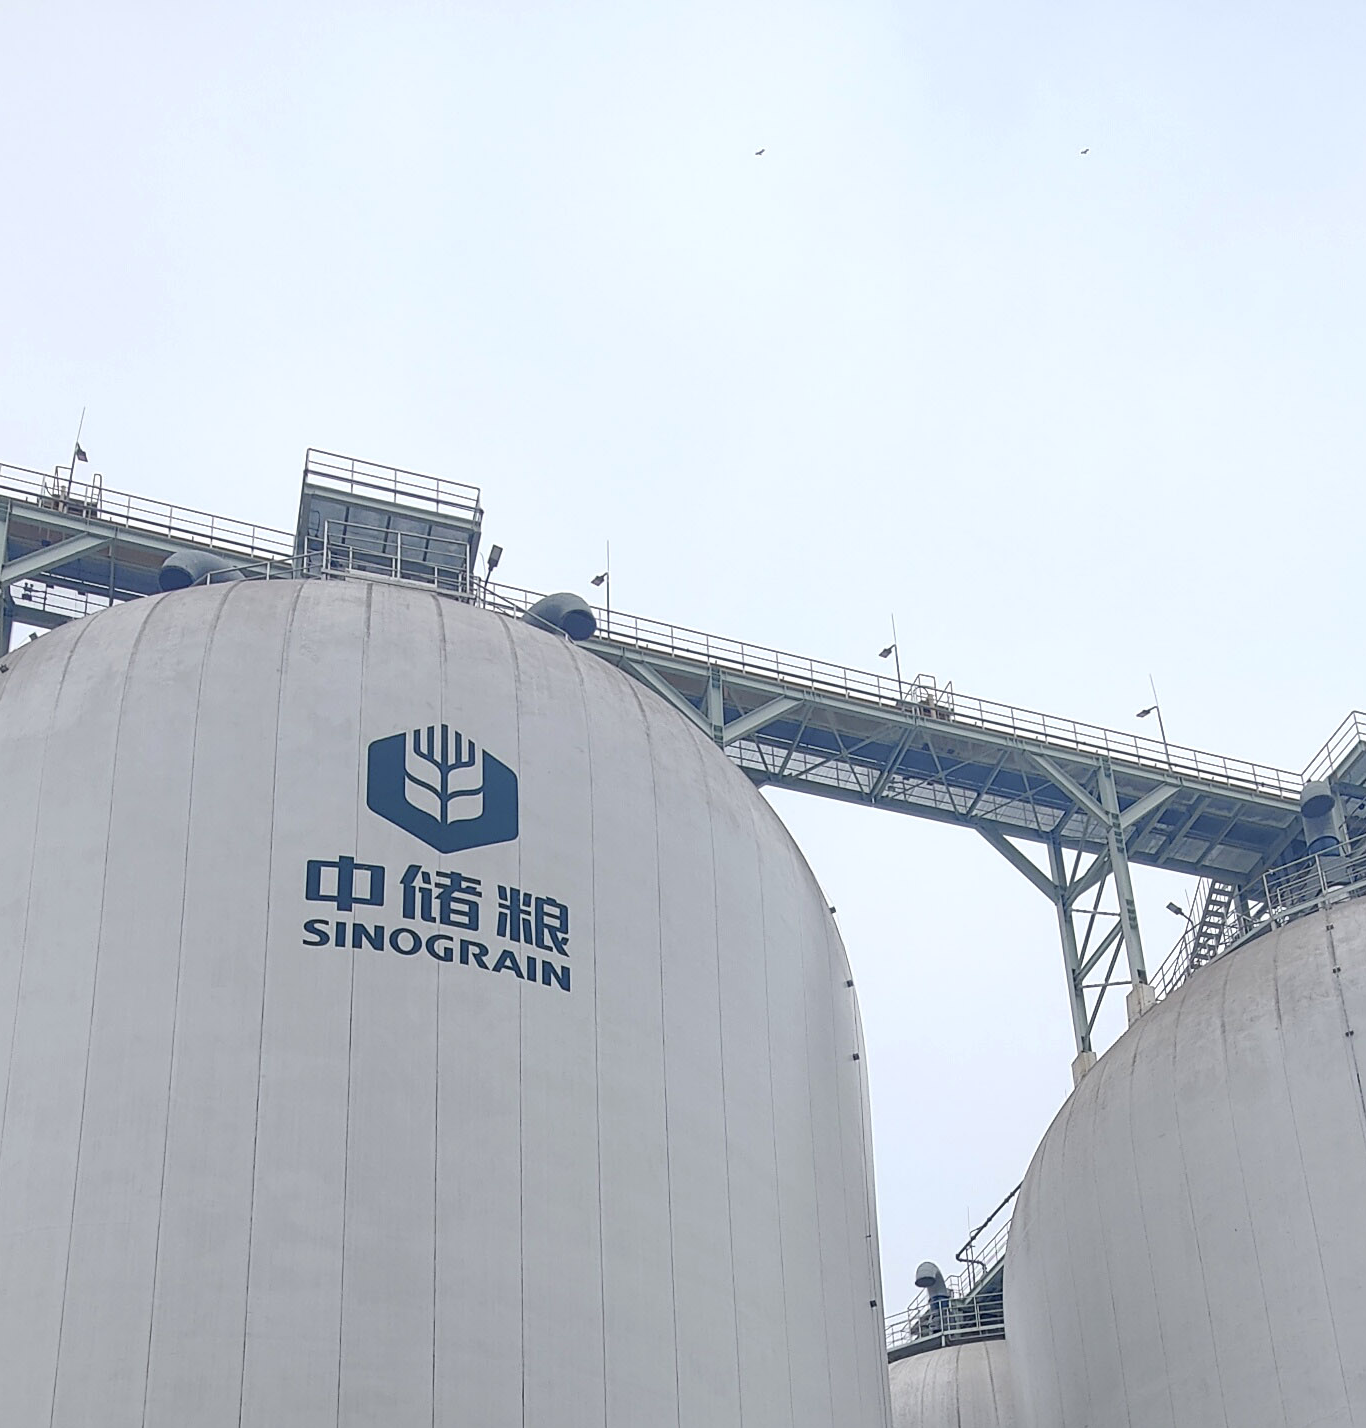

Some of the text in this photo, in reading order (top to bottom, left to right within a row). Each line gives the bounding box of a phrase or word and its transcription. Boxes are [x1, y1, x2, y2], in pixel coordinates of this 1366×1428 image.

[305, 855, 570, 958] 中储粮
[302, 918, 571, 993] SINOGRAIN
